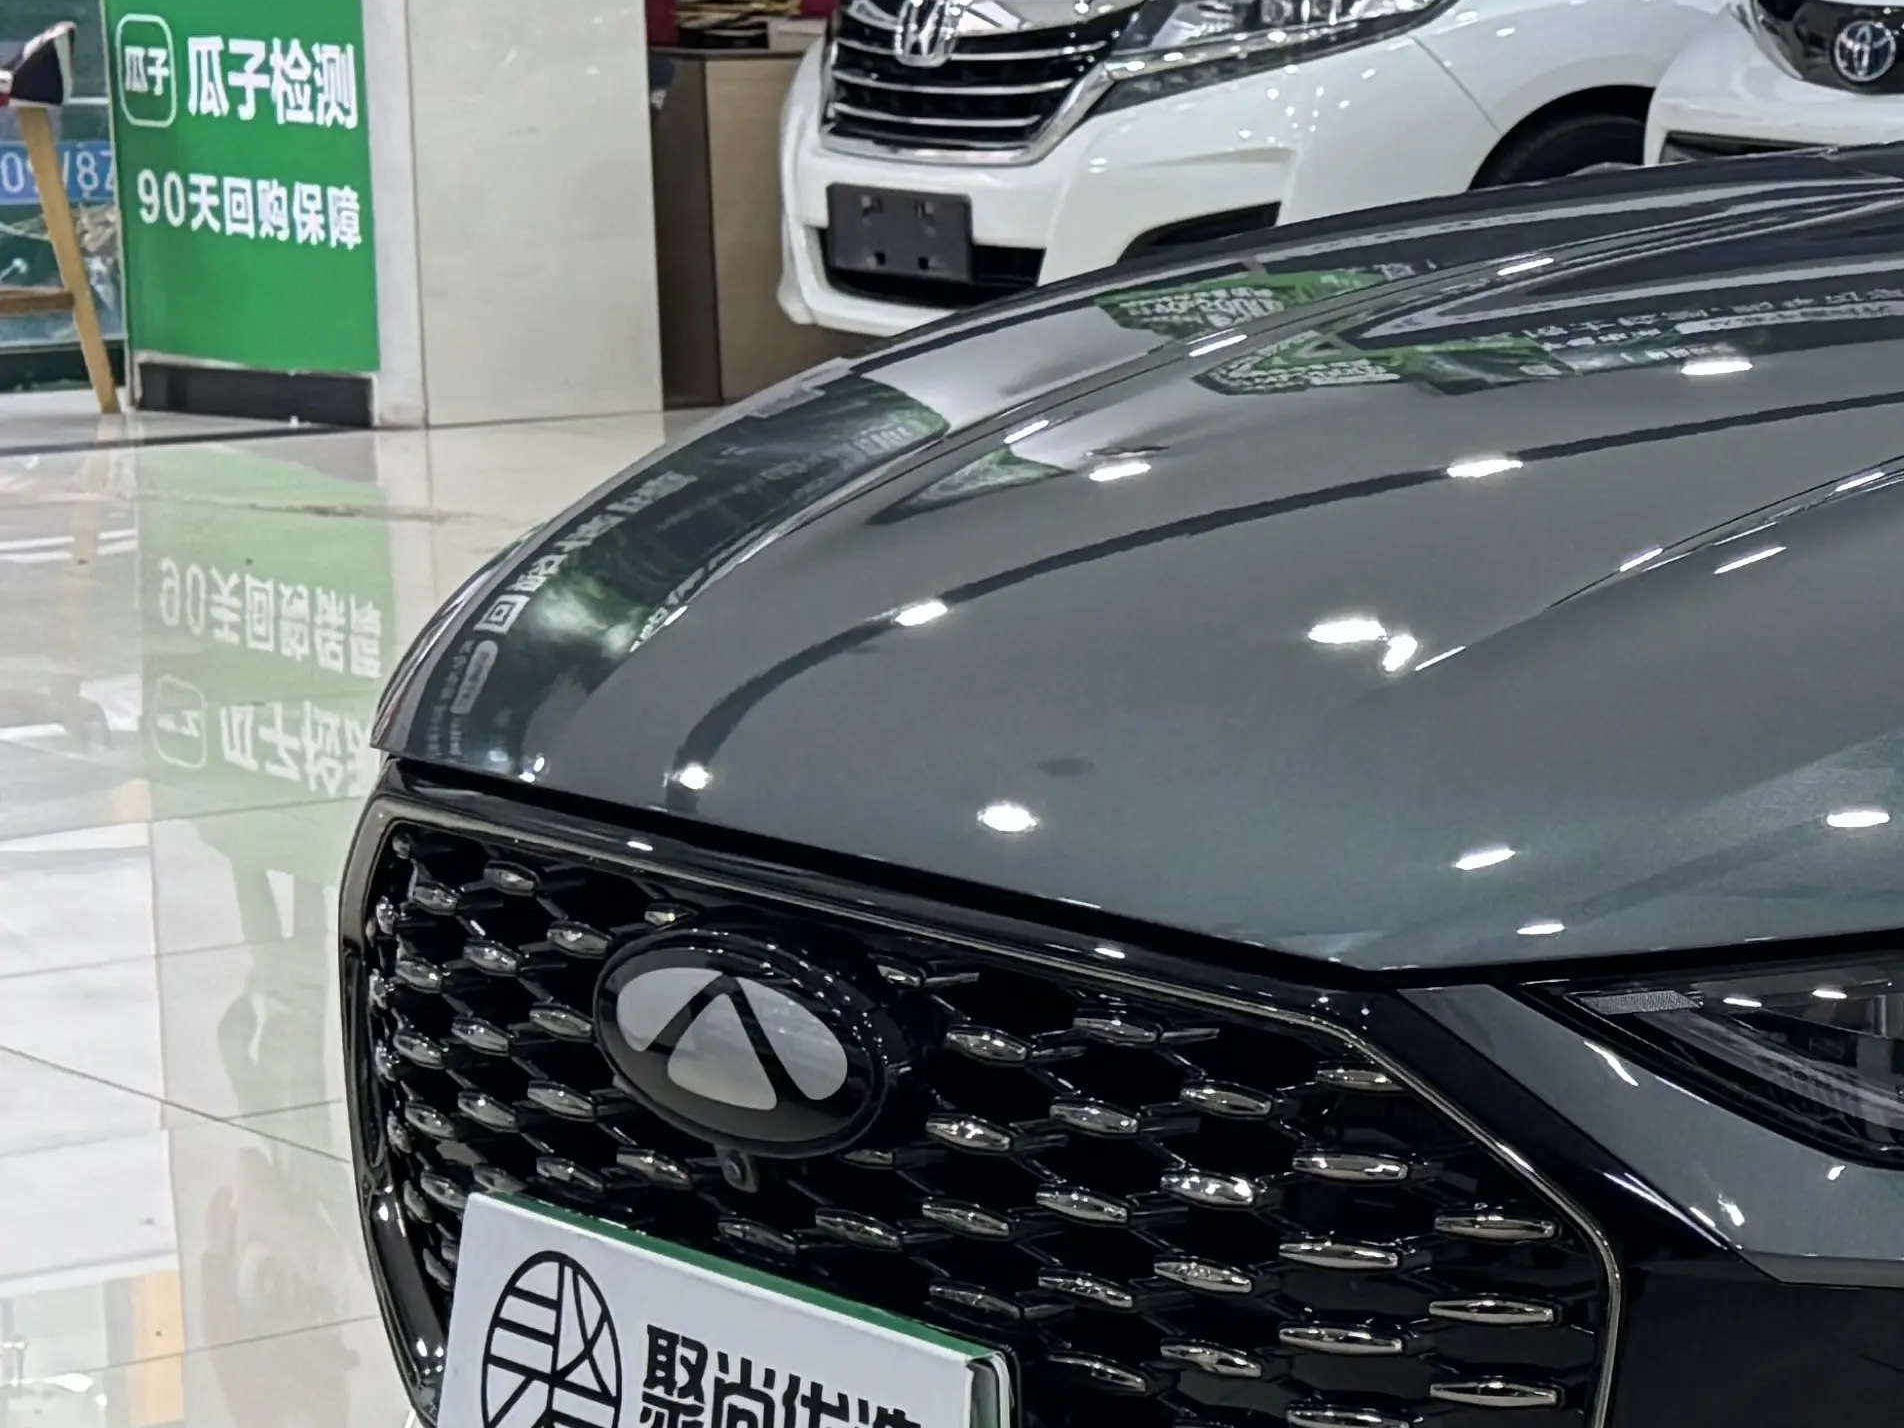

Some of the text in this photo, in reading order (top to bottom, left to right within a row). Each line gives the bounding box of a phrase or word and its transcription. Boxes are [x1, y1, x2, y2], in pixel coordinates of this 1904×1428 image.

[124, 34, 359, 130] 瓜子 瓜子检测
[137, 168, 363, 251] 90天回购保障
